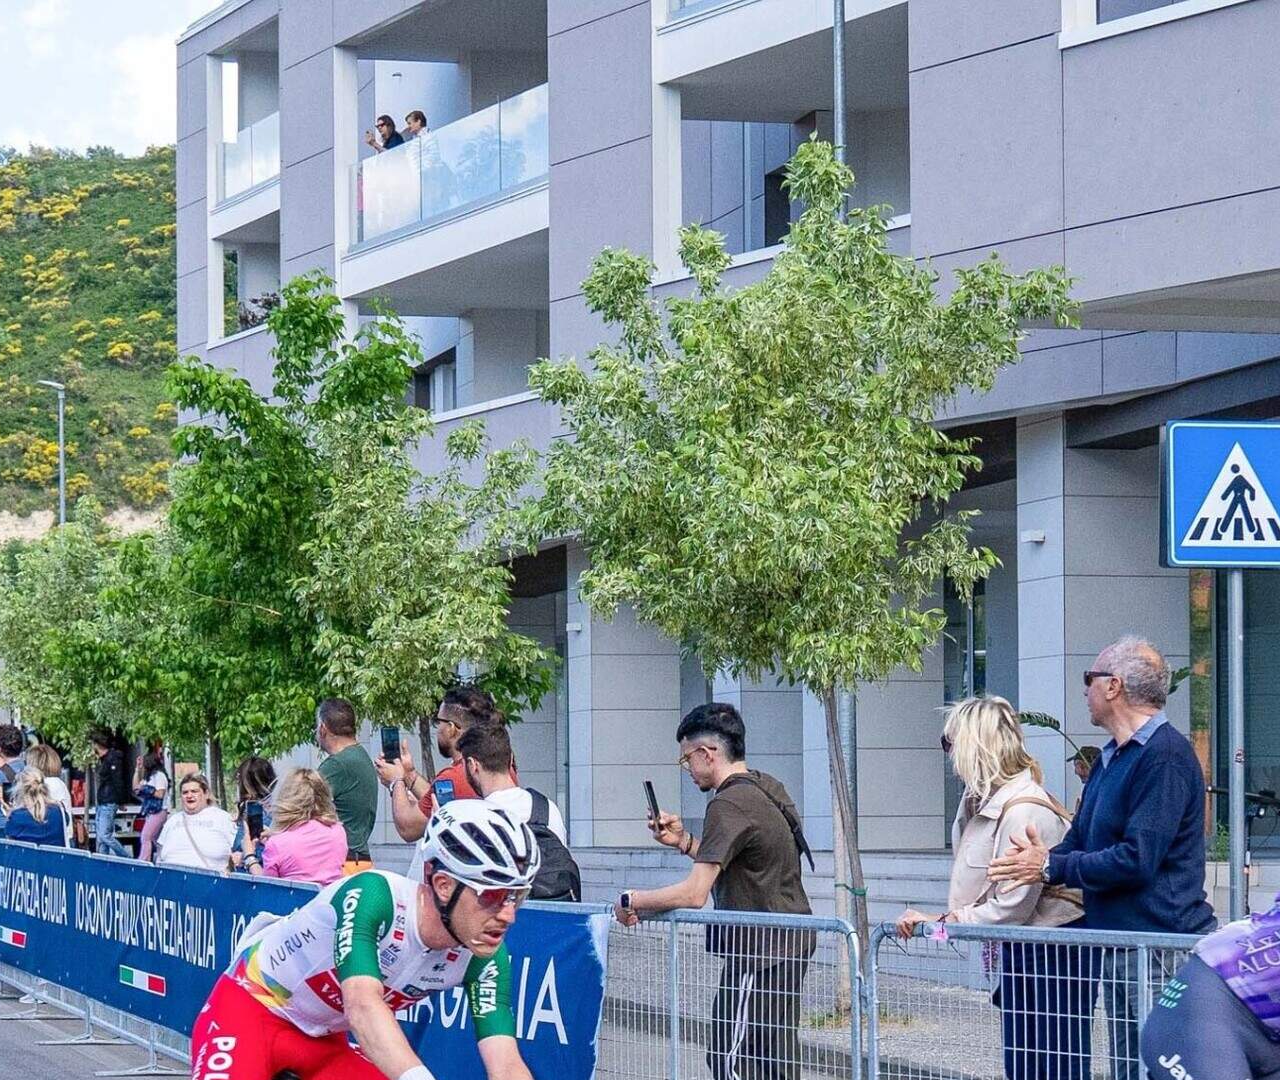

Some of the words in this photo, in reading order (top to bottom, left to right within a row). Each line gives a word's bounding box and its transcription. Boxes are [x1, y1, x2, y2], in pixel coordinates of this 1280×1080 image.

[41, 874, 68, 926] GIULIA
[75, 881, 84, 931] IO
[84, 883, 113, 939] SONO
[140, 895, 185, 959] VENEZIA
[185, 903, 216, 970] GIULIA
[336, 887, 363, 961] KOMETA
[269, 928, 317, 971] AURUM
[439, 954, 570, 1046] GIIA
